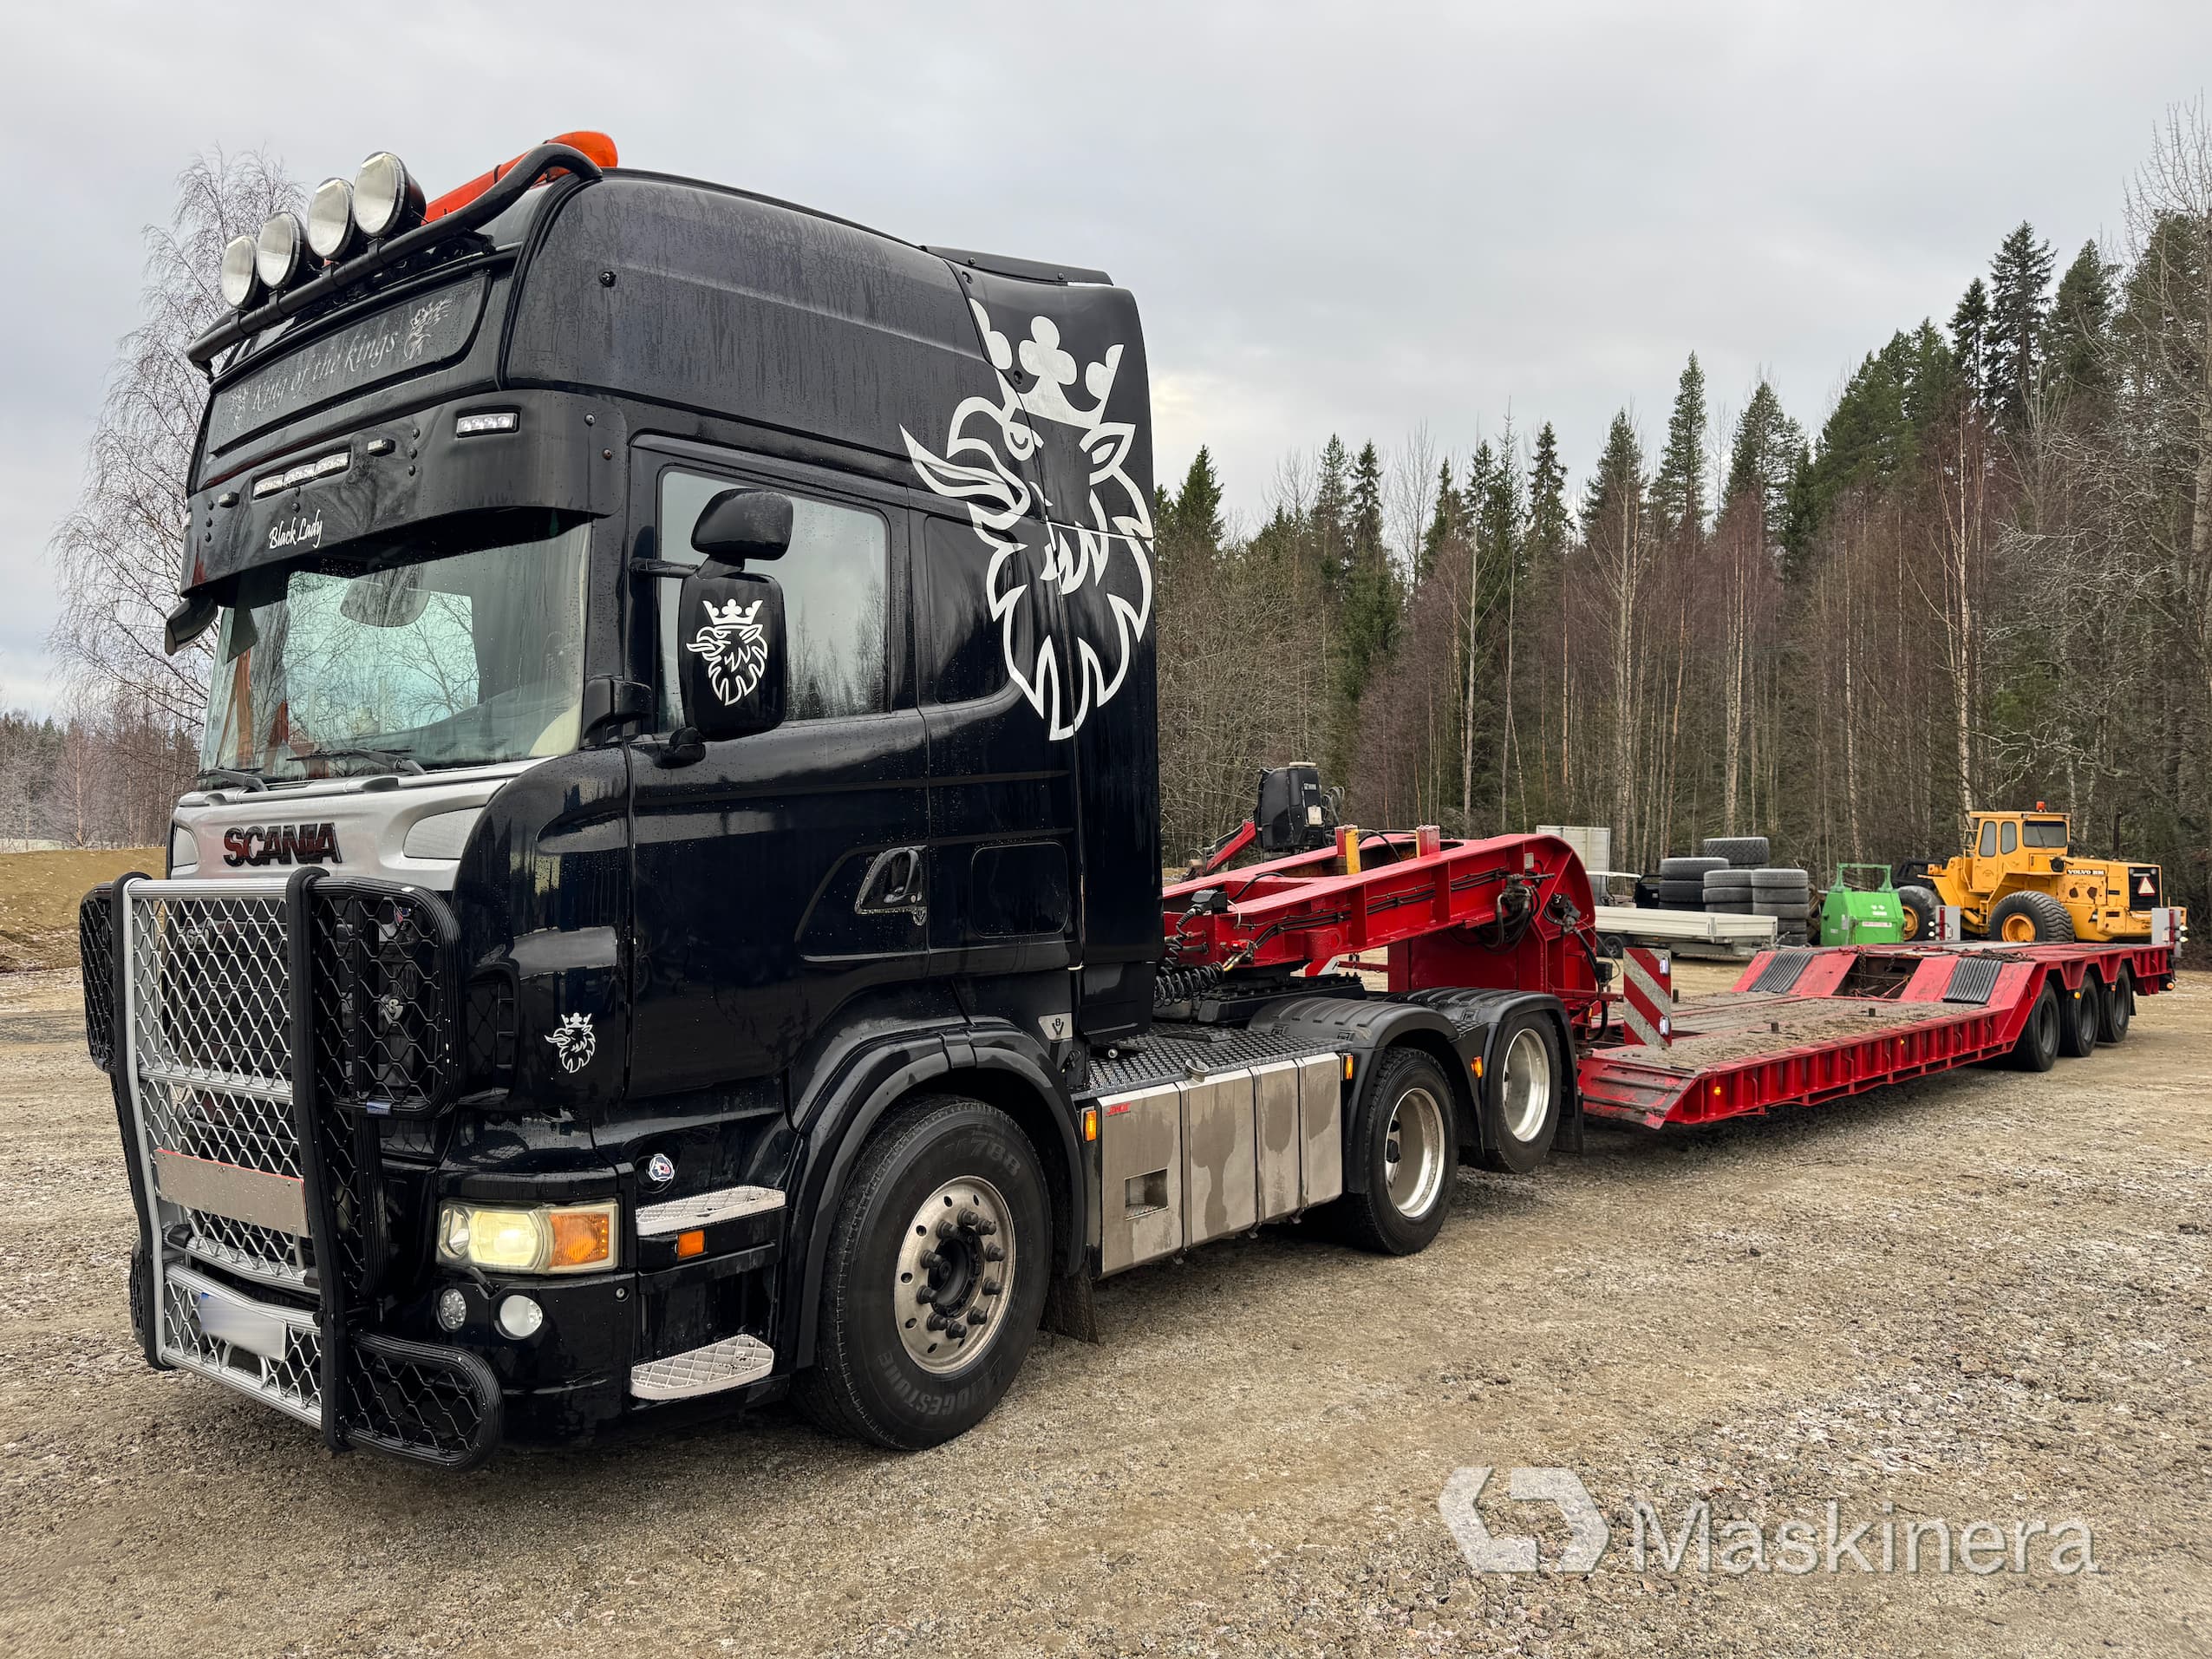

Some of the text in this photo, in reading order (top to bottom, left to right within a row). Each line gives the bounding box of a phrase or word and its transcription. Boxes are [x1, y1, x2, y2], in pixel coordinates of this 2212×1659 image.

[269, 508, 323, 549] Black Lady
[223, 822, 343, 866] SCANIA
